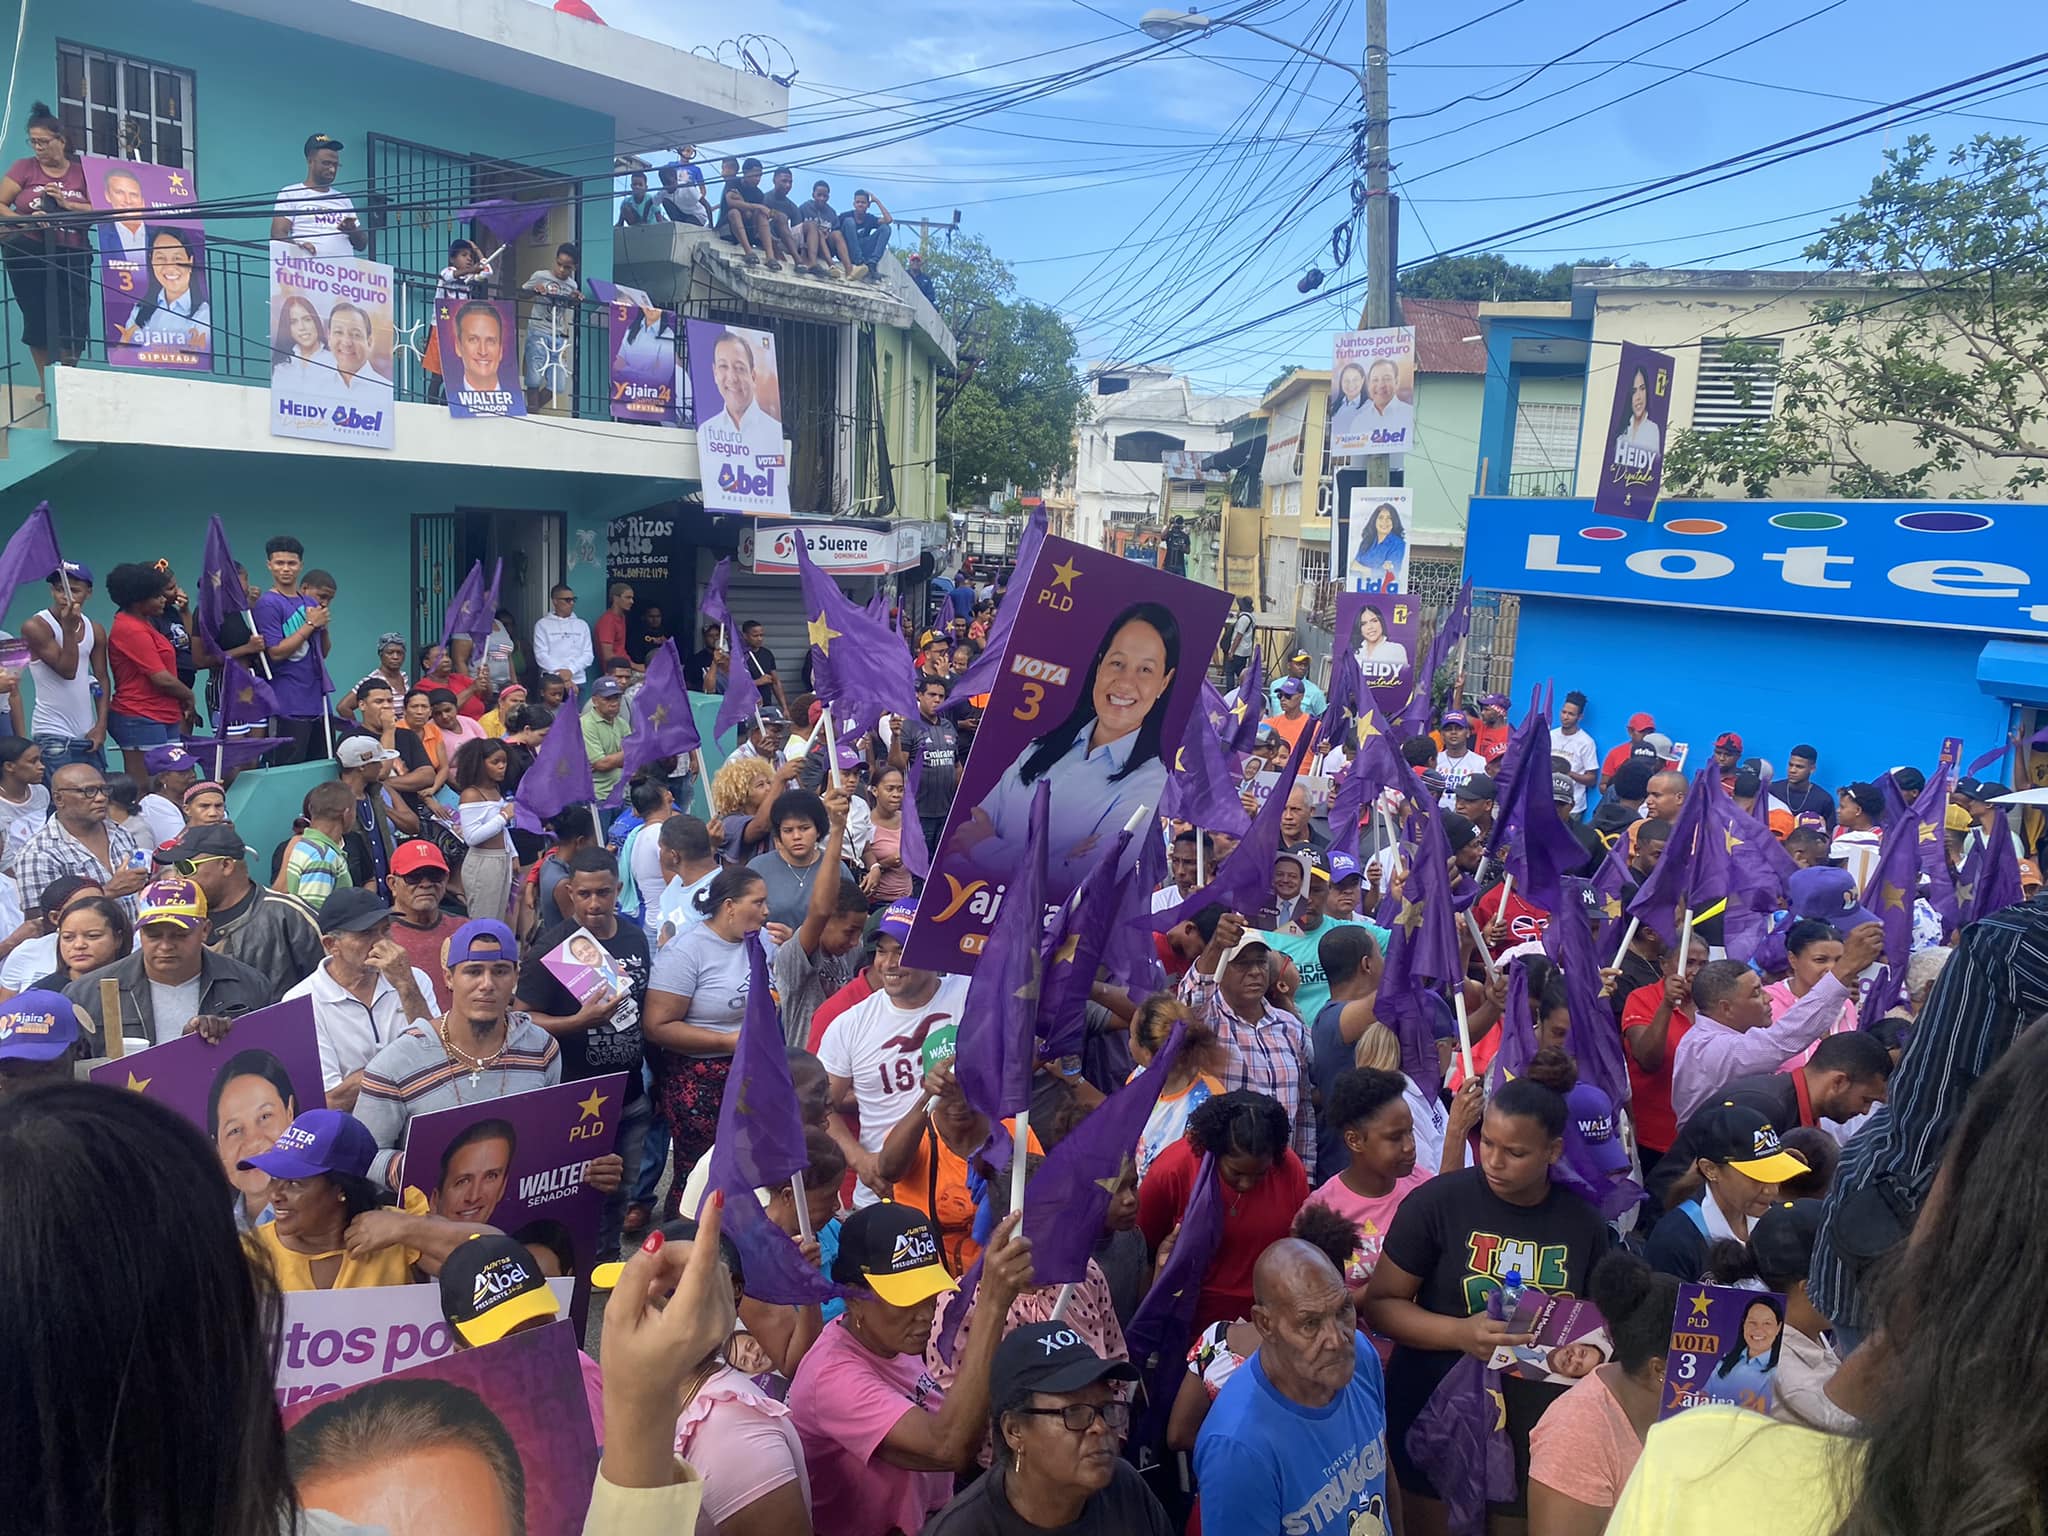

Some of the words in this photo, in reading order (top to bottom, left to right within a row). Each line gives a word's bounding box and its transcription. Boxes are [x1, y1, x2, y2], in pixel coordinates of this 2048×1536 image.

[169, 187, 189, 197] PLD
[108, 259, 139, 271] VOTA
[275, 251, 335, 277] Juntos
[338, 266, 365, 282] por
[367, 271, 388, 288] un
[119, 271, 134, 291] 3
[275, 267, 328, 292] futuro
[331, 282, 387, 304] seguro
[618, 306, 627, 322] 3
[113, 322, 186, 346] Yajaira
[1336, 337, 1374, 348] Juntos
[1375, 335, 1395, 348] por
[1397, 332, 1412, 343] un
[138, 352, 198, 365] DIPUTADA
[1336, 348, 1370, 359] futuro
[1371, 345, 1411, 358] seguro
[458, 391, 514, 406] WALTER
[613, 380, 658, 400] Yajaira
[658, 384, 671, 402] 24
[279, 398, 328, 419] HEIDY
[331, 405, 383, 432] Abel
[707, 426, 743, 443] futuro
[710, 442, 750, 457] seguro
[1614, 443, 1657, 471] HEIDY
[757, 456, 776, 465] VOTA
[718, 463, 775, 497] Abel
[1037, 588, 1074, 613] PLD
[1010, 654, 1071, 686] VOTA
[1360, 662, 1404, 678] EIDY
[1013, 683, 1047, 721] 3
[165, 898, 188, 906] PLD
[928, 1041, 957, 1060] WALT
[569, 1121, 604, 1143] PLD
[1577, 1118, 1612, 1132] WALT
[286, 1126, 316, 1146] LTER
[527, 1186, 579, 1208] SENADOR
[481, 1256, 511, 1274] JUNTOS
[1467, 1231, 1568, 1289] THE
[472, 1262, 530, 1306] Abel
[1686, 1317, 1709, 1328] PLD
[285, 1322, 377, 1369] tos
[382, 1321, 454, 1374] po
[1675, 1334, 1716, 1353] VOTA
[1678, 1353, 1697, 1380] 3
[1281, 1427, 1387, 1536] STRUGGL
